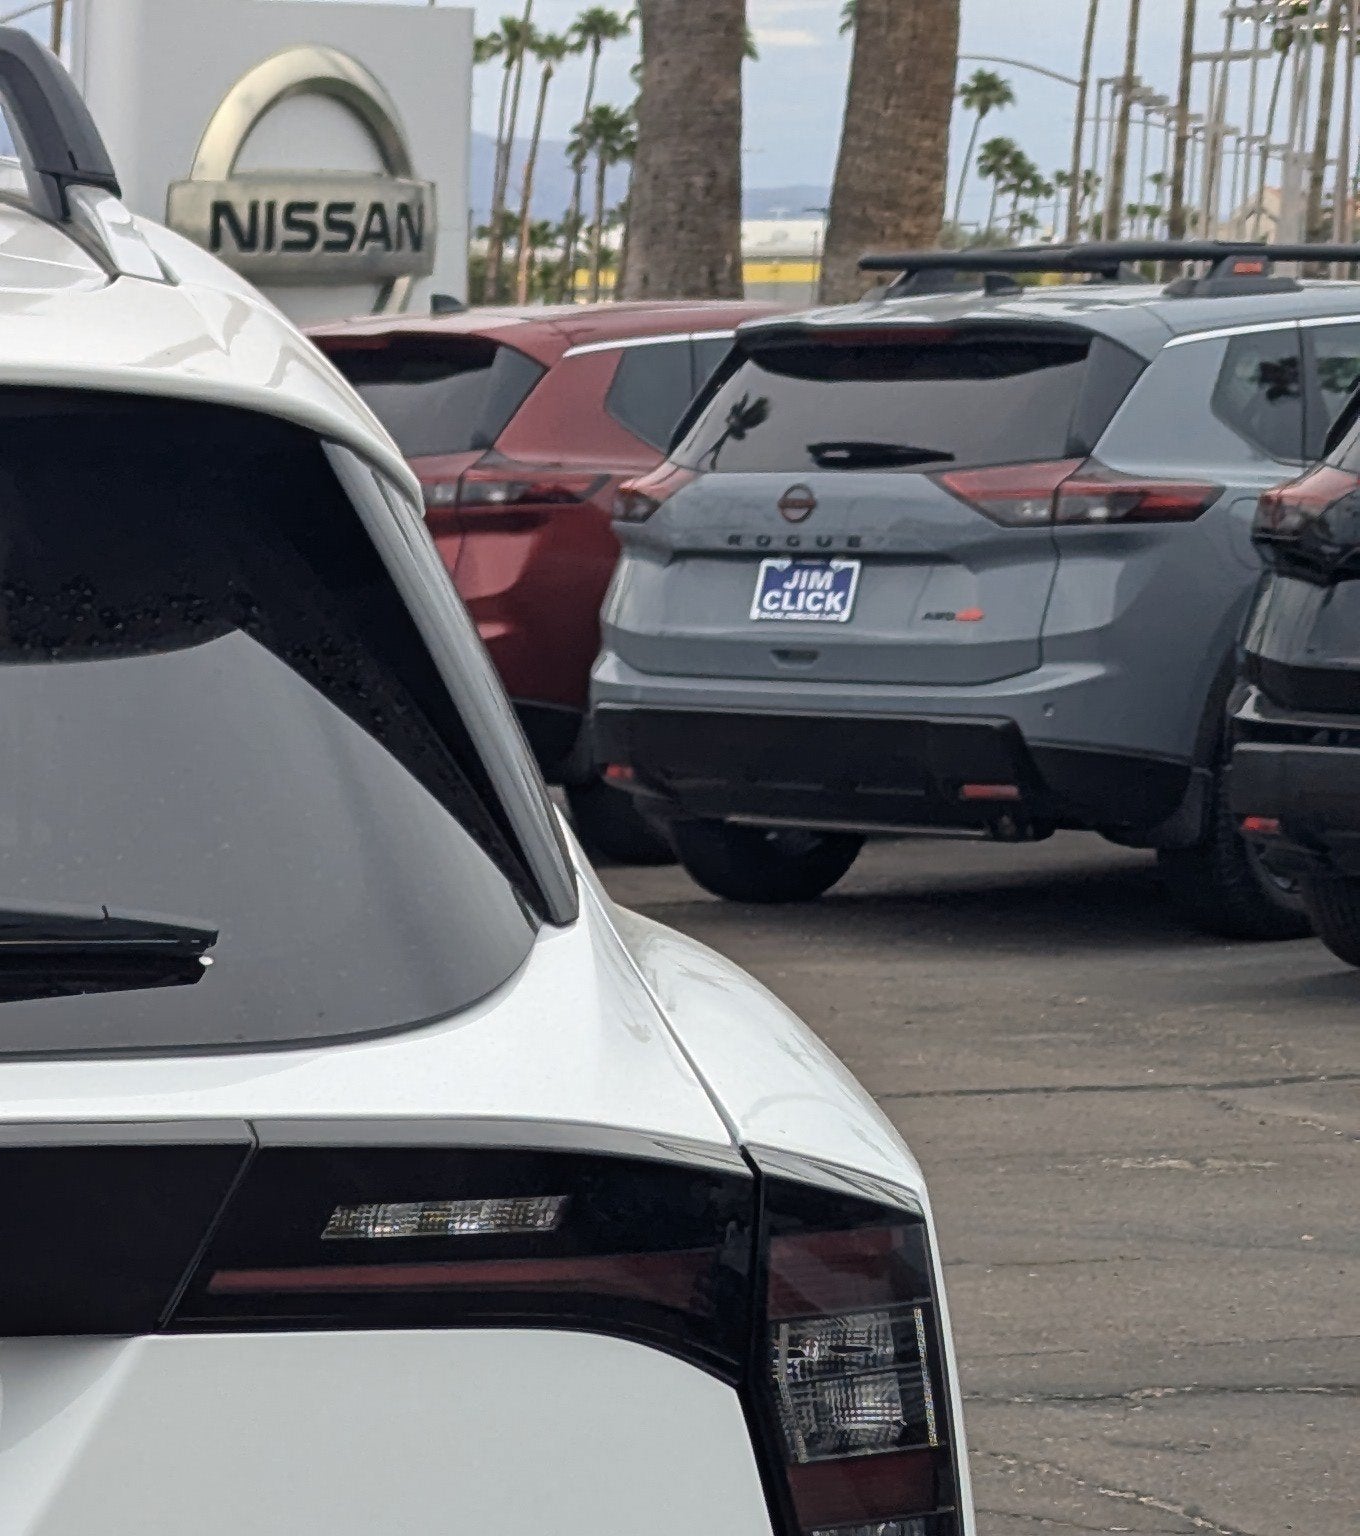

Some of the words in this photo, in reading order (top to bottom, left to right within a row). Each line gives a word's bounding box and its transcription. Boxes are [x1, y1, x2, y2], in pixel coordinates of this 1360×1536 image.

[211, 200, 422, 252] NISSAN
[728, 534, 861, 547] ROGUE
[783, 569, 833, 590] JIM
[762, 590, 845, 612] CLICK
